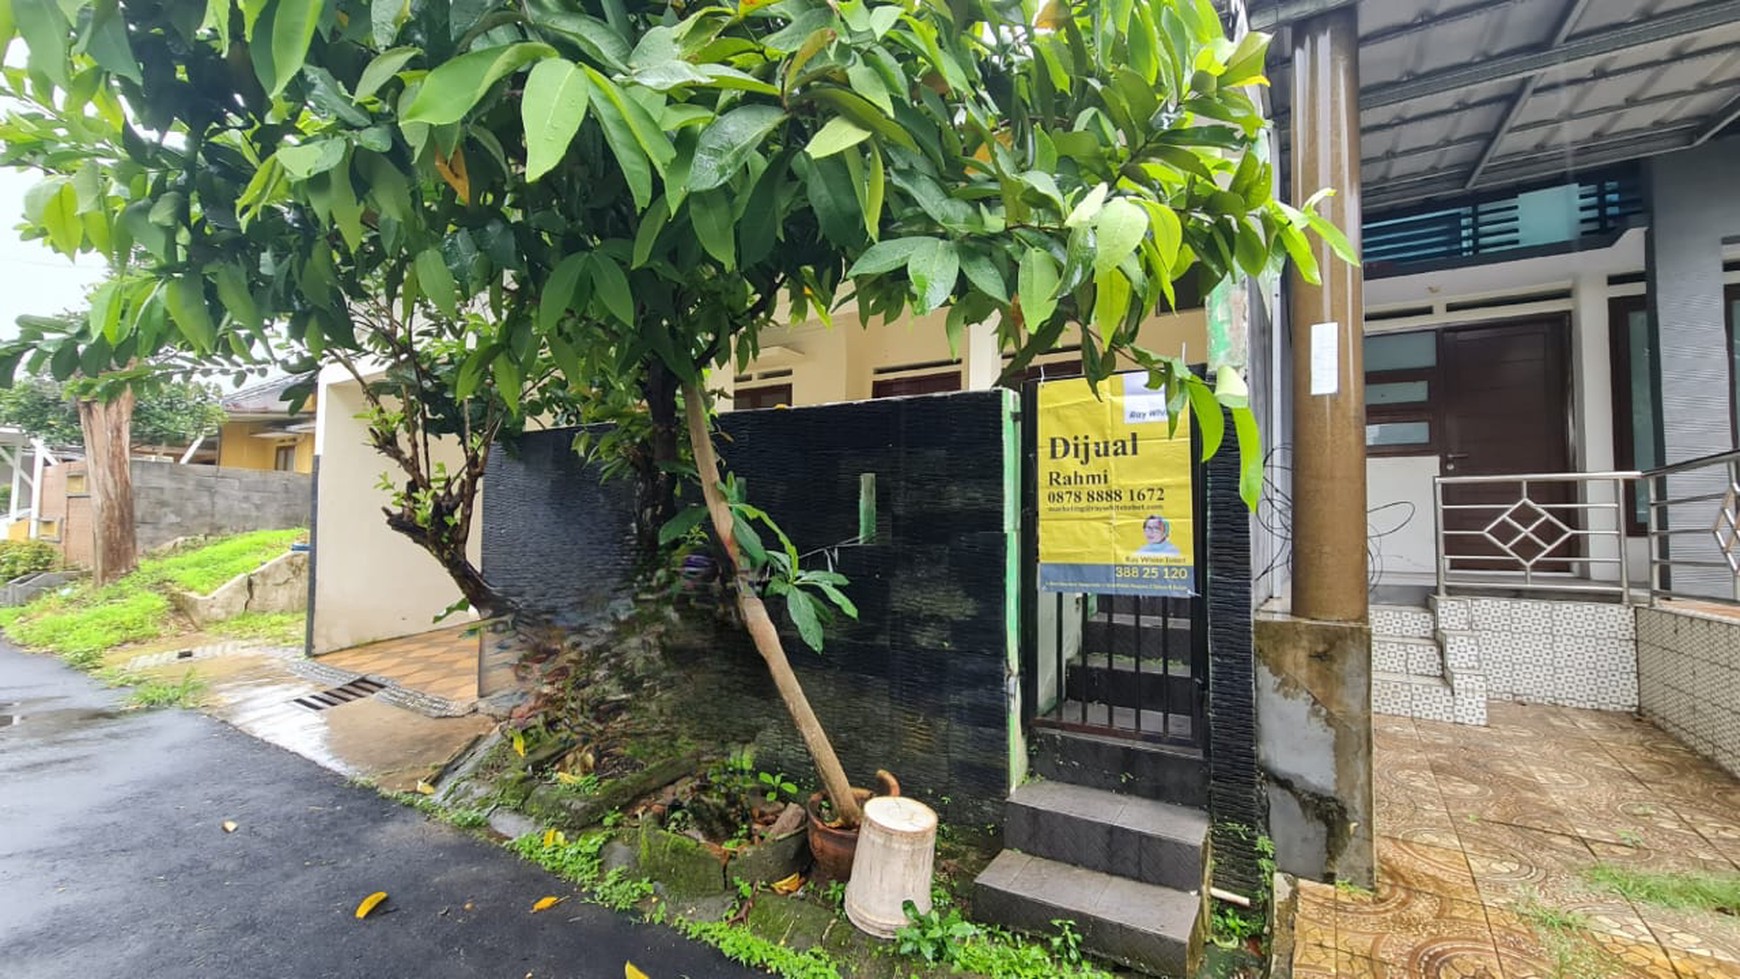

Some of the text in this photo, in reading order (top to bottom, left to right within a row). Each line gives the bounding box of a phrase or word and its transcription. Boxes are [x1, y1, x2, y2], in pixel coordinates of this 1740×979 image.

[1050, 432, 1138, 465] Dijual
[1049, 470, 1108, 486] Rahmi
[1048, 488, 1165, 503] 0878 8888 1672
[1115, 566, 1188, 579] 388 25 120
